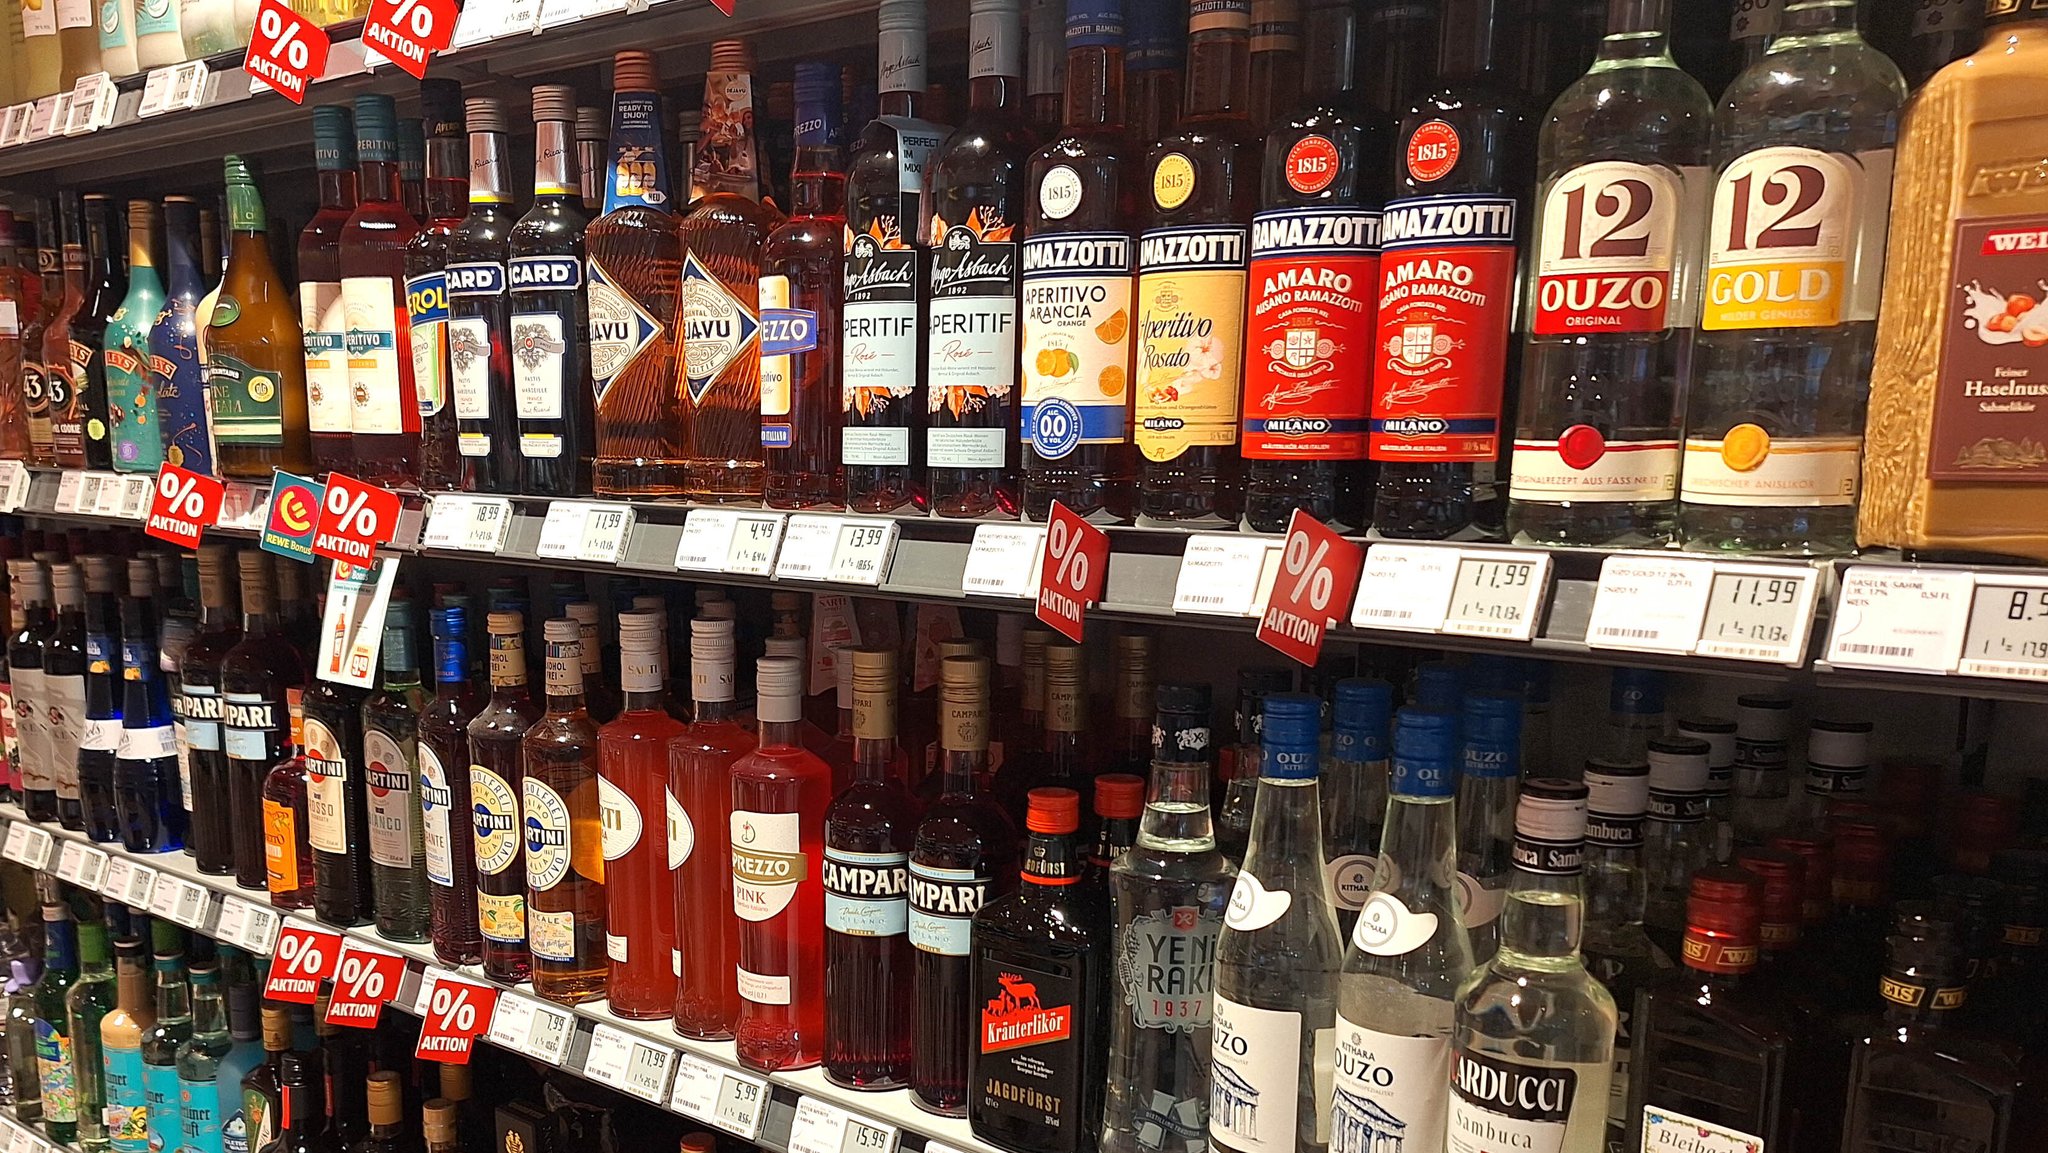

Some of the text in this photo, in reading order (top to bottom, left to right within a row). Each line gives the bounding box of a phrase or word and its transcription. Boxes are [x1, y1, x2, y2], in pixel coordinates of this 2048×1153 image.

[368, 22, 425, 63] AKTION
[249, 55, 302, 93] AKTION
[902, 136, 940, 147] PERFECT
[1416, 143, 1447, 162] 1815
[1296, 157, 1328, 174] 1815
[1161, 173, 1184, 190] 1815
[1048, 185, 1071, 201] 1815
[1727, 165, 1826, 252] 12
[1560, 179, 1654, 260] 12
[856, 258, 913, 286] Asbach
[949, 251, 1013, 283] Asbach
[1385, 260, 1474, 291] AMARO
[947, 286, 967, 295] 1892
[1264, 266, 1353, 297] AMARO
[1711, 268, 1832, 306] GOLD
[854, 291, 871, 300] 1892
[1025, 285, 1106, 305] APERITIVO
[1294, 290, 1363, 313] RAMAZZOTTI
[1411, 283, 1486, 307] RAMAZZOTTI
[1541, 276, 1664, 312] OUZO
[1030, 305, 1091, 325] ARANCIA
[1057, 319, 1086, 327] ORANGE
[1565, 315, 1622, 327] ORIGINAL
[1141, 311, 1212, 346] Aperitivo
[851, 343, 877, 364] Rosé
[943, 340, 973, 364] Rosé
[1144, 345, 1190, 371] Rosato
[1994, 366, 2028, 378] Feiner
[47, 381, 65, 402] 43
[1145, 419, 1182, 429] MILANO
[1268, 420, 1325, 432] MILANO
[1385, 420, 1441, 432] MILANO
[1581, 476, 1604, 486] AUS
[1607, 475, 1632, 486] FASS
[476, 506, 500, 522] 18.99
[594, 513, 621, 530] 11.99
[150, 516, 198, 538] AKTION
[751, 522, 774, 540] 4.49
[266, 534, 312, 556] REWE Bonus
[316, 533, 370, 559] AKTION
[850, 529, 882, 548] 13.99
[1475, 564, 1530, 589] 11.99
[1892, 581, 1924, 590] SAHNE
[1733, 579, 1798, 607] 11.99
[1040, 587, 1080, 624] AKTION
[1263, 606, 1320, 647] AKTION
[733, 857, 790, 877] PREZZO
[736, 885, 767, 905] PINK
[840, 916, 885, 925] MILANO
[268, 978, 316, 993] AKTION
[330, 1002, 377, 1018] AKTION
[1152, 999, 1203, 1018] 1937
[546, 1015, 564, 1033] 7.99
[988, 1012, 1064, 1044] Kräuterlikör
[420, 1036, 469, 1052] AKTION
[1342, 1043, 1375, 1062] KITHARA
[640, 1048, 666, 1069] 17.99
[1334, 1047, 1394, 1087] OUZO
[735, 1083, 758, 1102] 5.99
[986, 1078, 1061, 1115] JAGDFÜRST
[856, 1126, 886, 1150] 15.99
[1455, 1107, 1533, 1150] Sambuca
